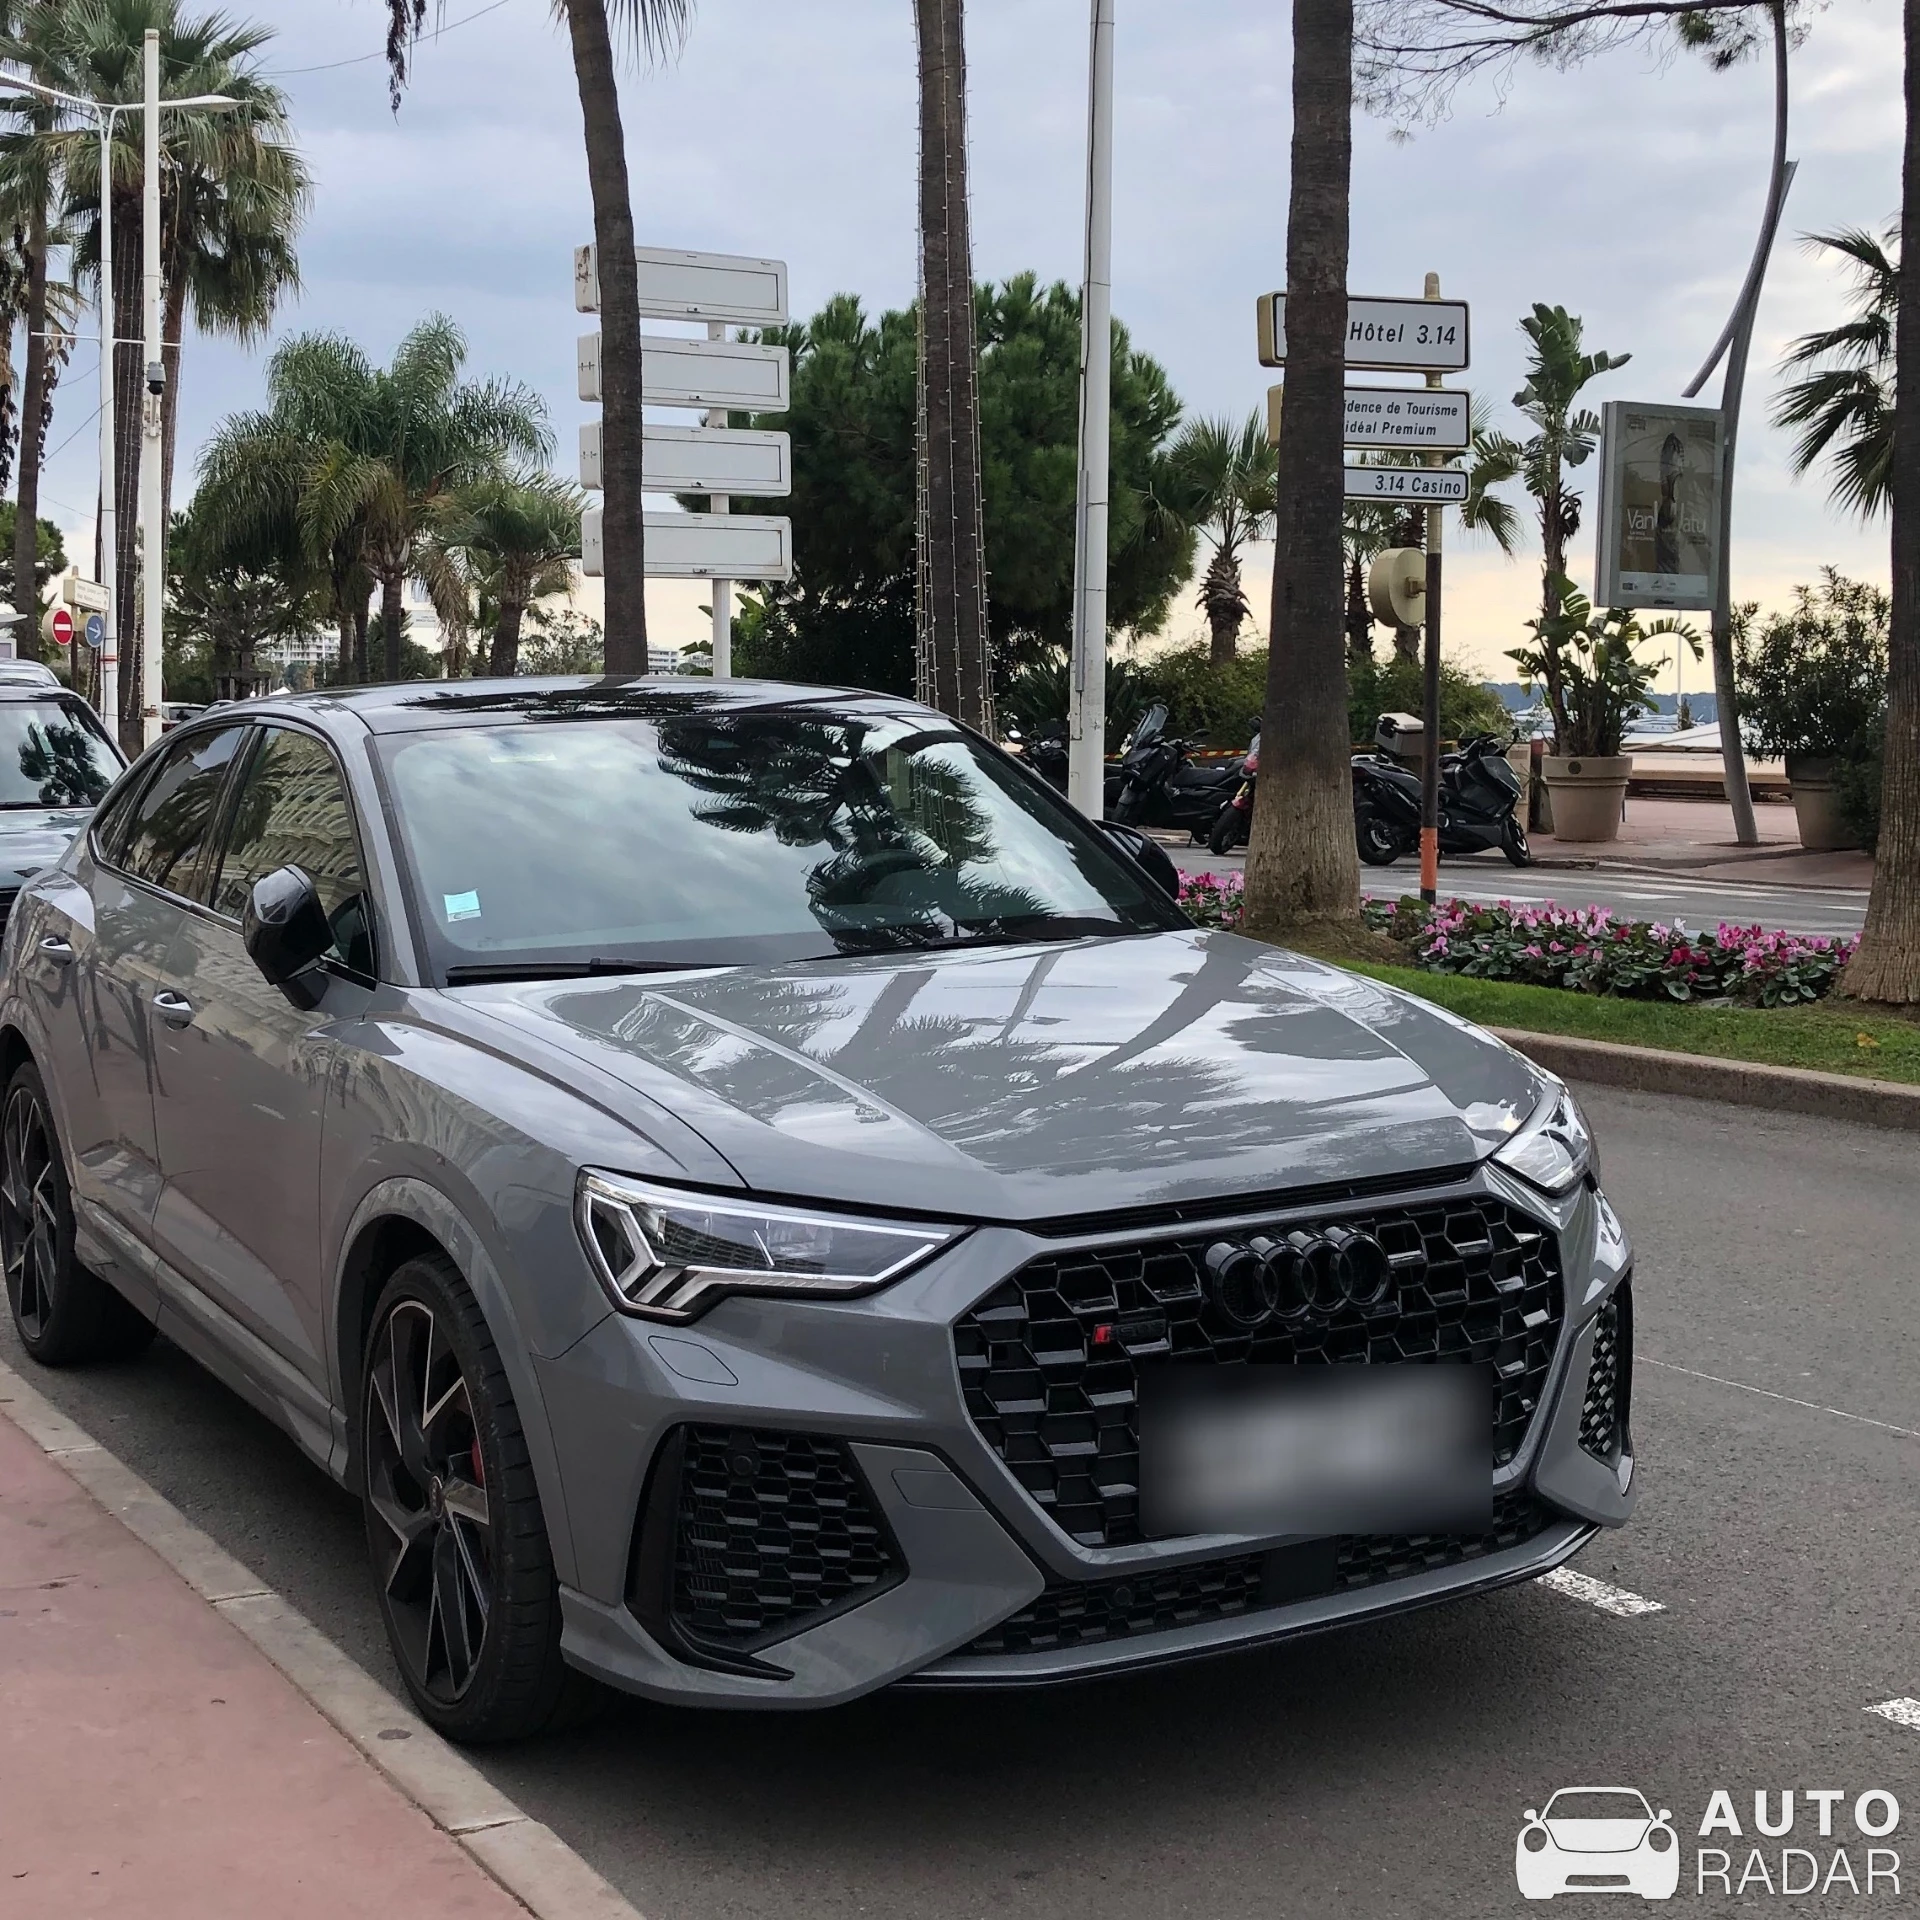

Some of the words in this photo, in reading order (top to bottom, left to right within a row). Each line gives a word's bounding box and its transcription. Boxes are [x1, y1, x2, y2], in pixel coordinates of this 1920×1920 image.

[1349, 321, 1404, 343] Hôtel
[1416, 324, 1456, 345] 3.14
[1386, 401, 1401, 414] de
[1406, 401, 1458, 417] Tourisme
[1381, 421, 1437, 436] Premium
[1375, 474, 1405, 492] 3.14
[1411, 476, 1461, 494] Casino
